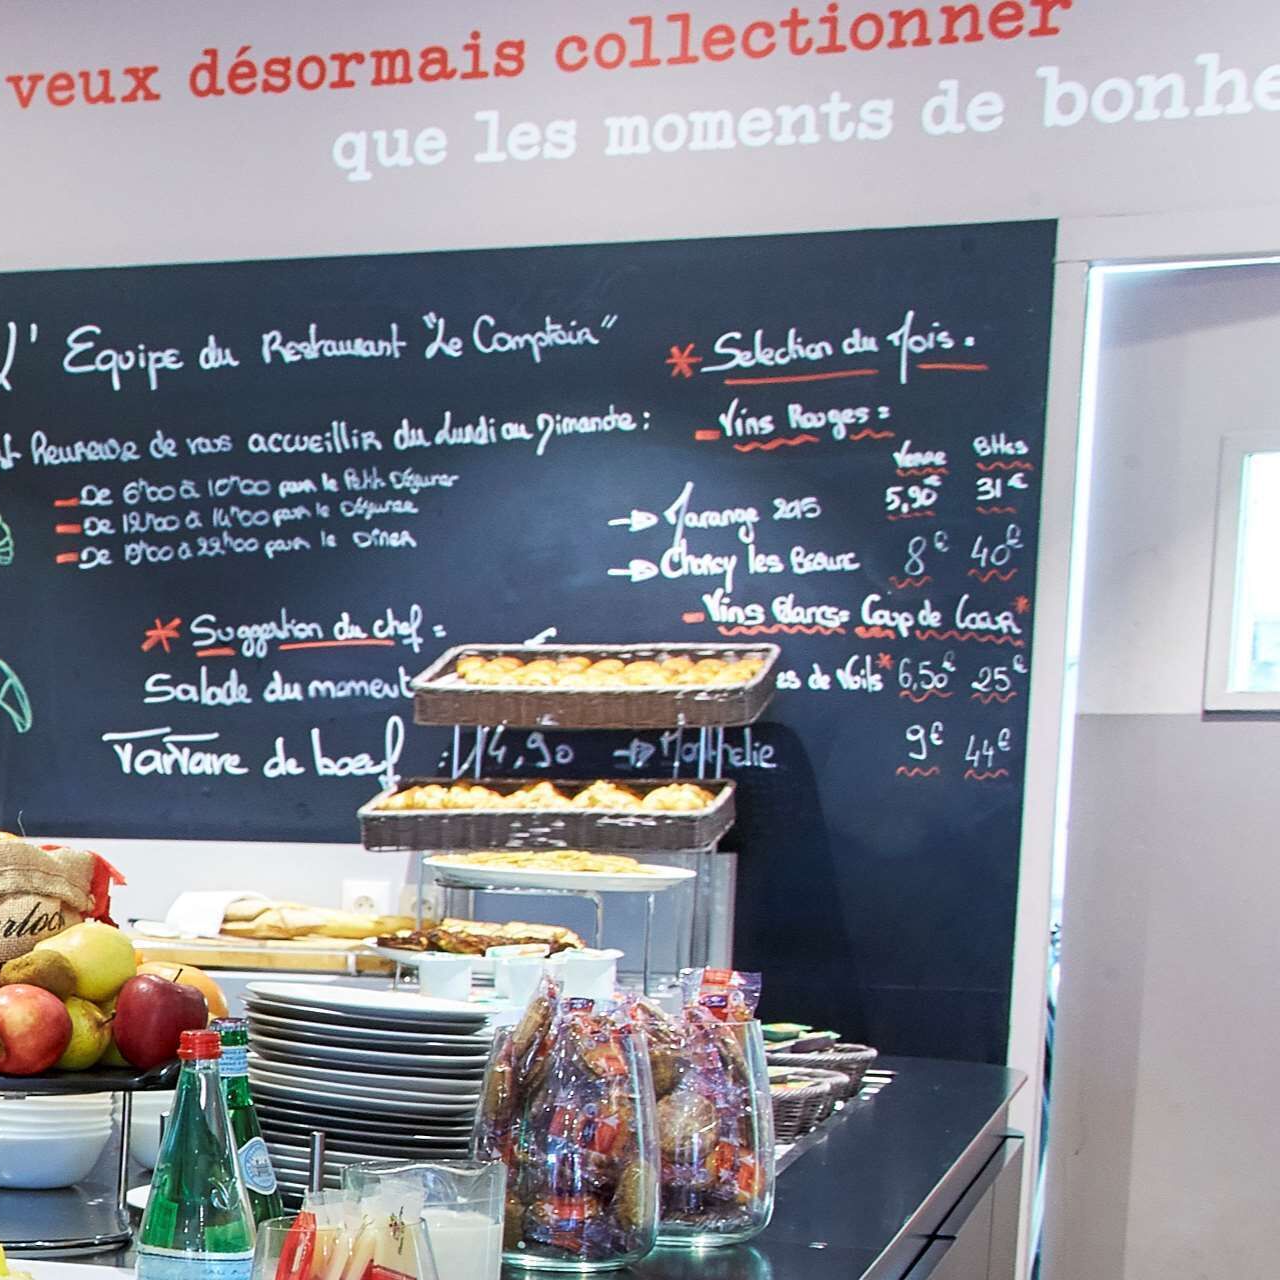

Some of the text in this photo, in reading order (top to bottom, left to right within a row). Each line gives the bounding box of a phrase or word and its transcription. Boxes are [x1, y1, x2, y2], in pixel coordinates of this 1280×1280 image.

[5, 65, 161, 109] veux
[188, 29, 527, 99] désormais
[554, 0, 1073, 73] collectionner
[332, 123, 449, 183] que
[474, 109, 579, 164] les
[603, 90, 894, 157] moments
[921, 79, 1005, 136] de
[199, 334, 239, 370] du
[842, 328, 878, 354] du
[719, 397, 774, 438] Vins
[149, 429, 178, 459] de
[247, 420, 383, 454] accueillir
[393, 418, 432, 451] du
[501, 421, 534, 441] au
[321, 472, 339, 492] le
[315, 502, 331, 518] le
[320, 530, 338, 548] le
[333, 611, 369, 641] du
[702, 587, 766, 626] Vins
[918, 599, 942, 628] de
[143, 665, 252, 706] Salade
[263, 670, 304, 702] du
[808, 663, 831, 690] de
[263, 736, 306, 778] de
